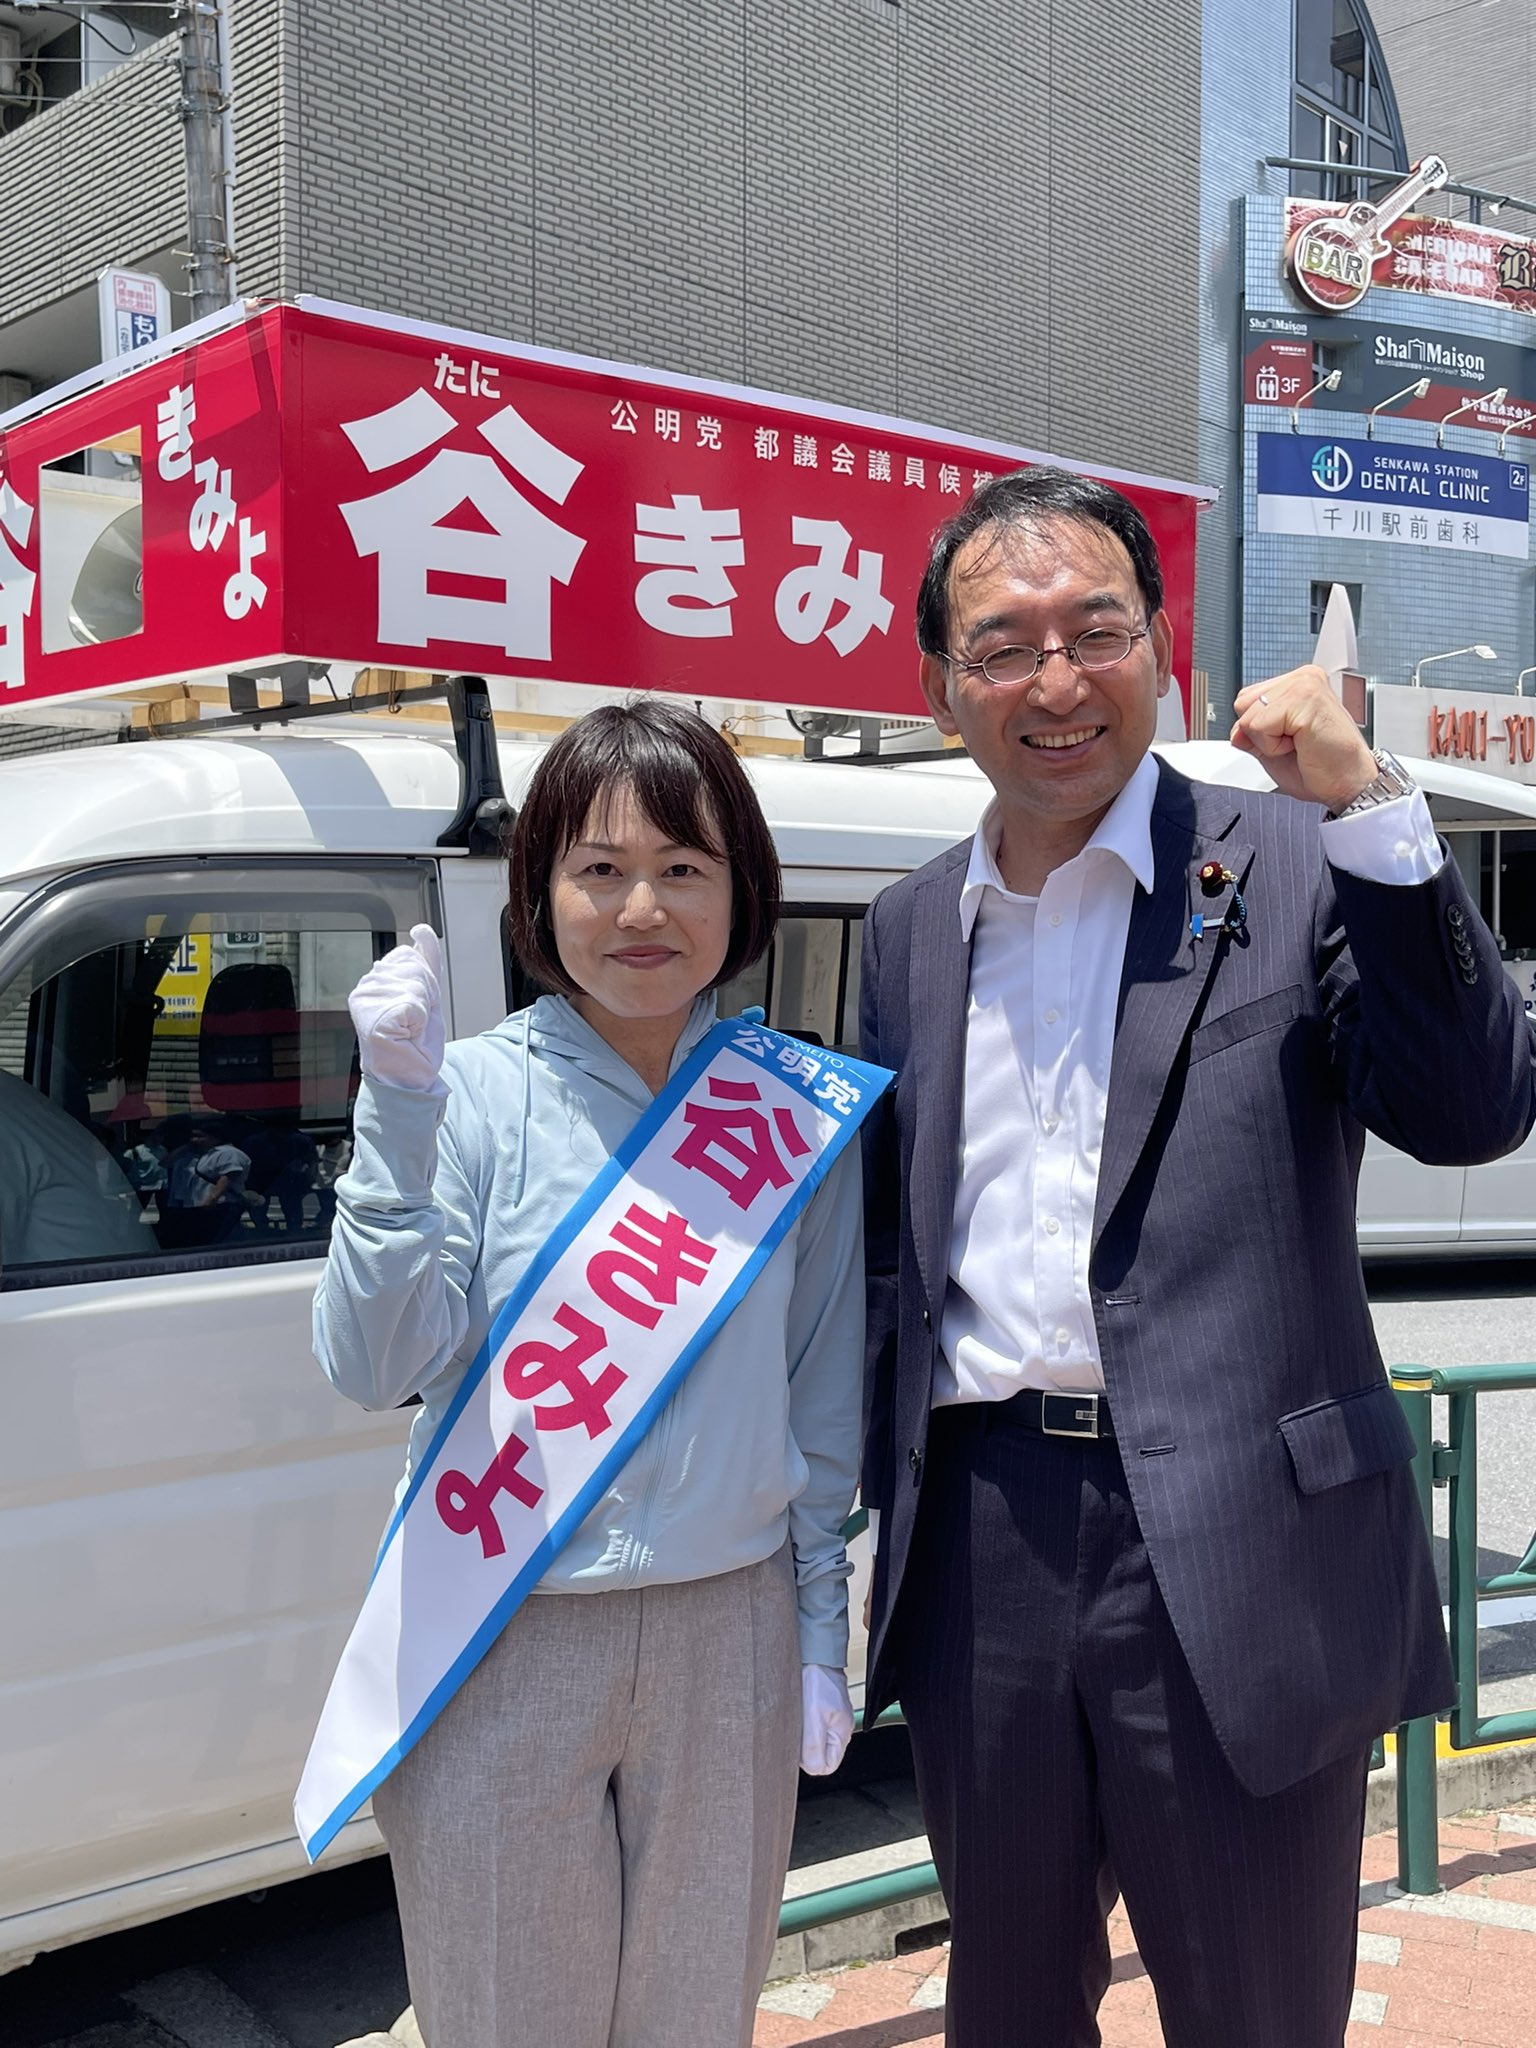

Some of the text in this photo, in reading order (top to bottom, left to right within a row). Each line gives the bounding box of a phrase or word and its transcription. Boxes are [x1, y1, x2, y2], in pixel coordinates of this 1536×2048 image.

[1303, 239, 1364, 286] BAR
[1375, 335, 1408, 360] Sha
[1426, 342, 1485, 372] Maison
[433, 353, 501, 399] たに
[1281, 377, 1301, 394] 3F
[1459, 368, 1485, 382] Shop
[610, 400, 722, 450] 公明党
[1360, 471, 1491, 504] DENTAL CLINIC
[1374, 456, 1479, 480] SENKAWA STATION
[1511, 469, 1526, 486] 2F
[157, 383, 268, 620] きみよ
[1322, 507, 1481, 546] 千川駅前歯科
[731, 1029, 862, 1117] 公明党
[435, 1075, 812, 1560] 谷きみよ
